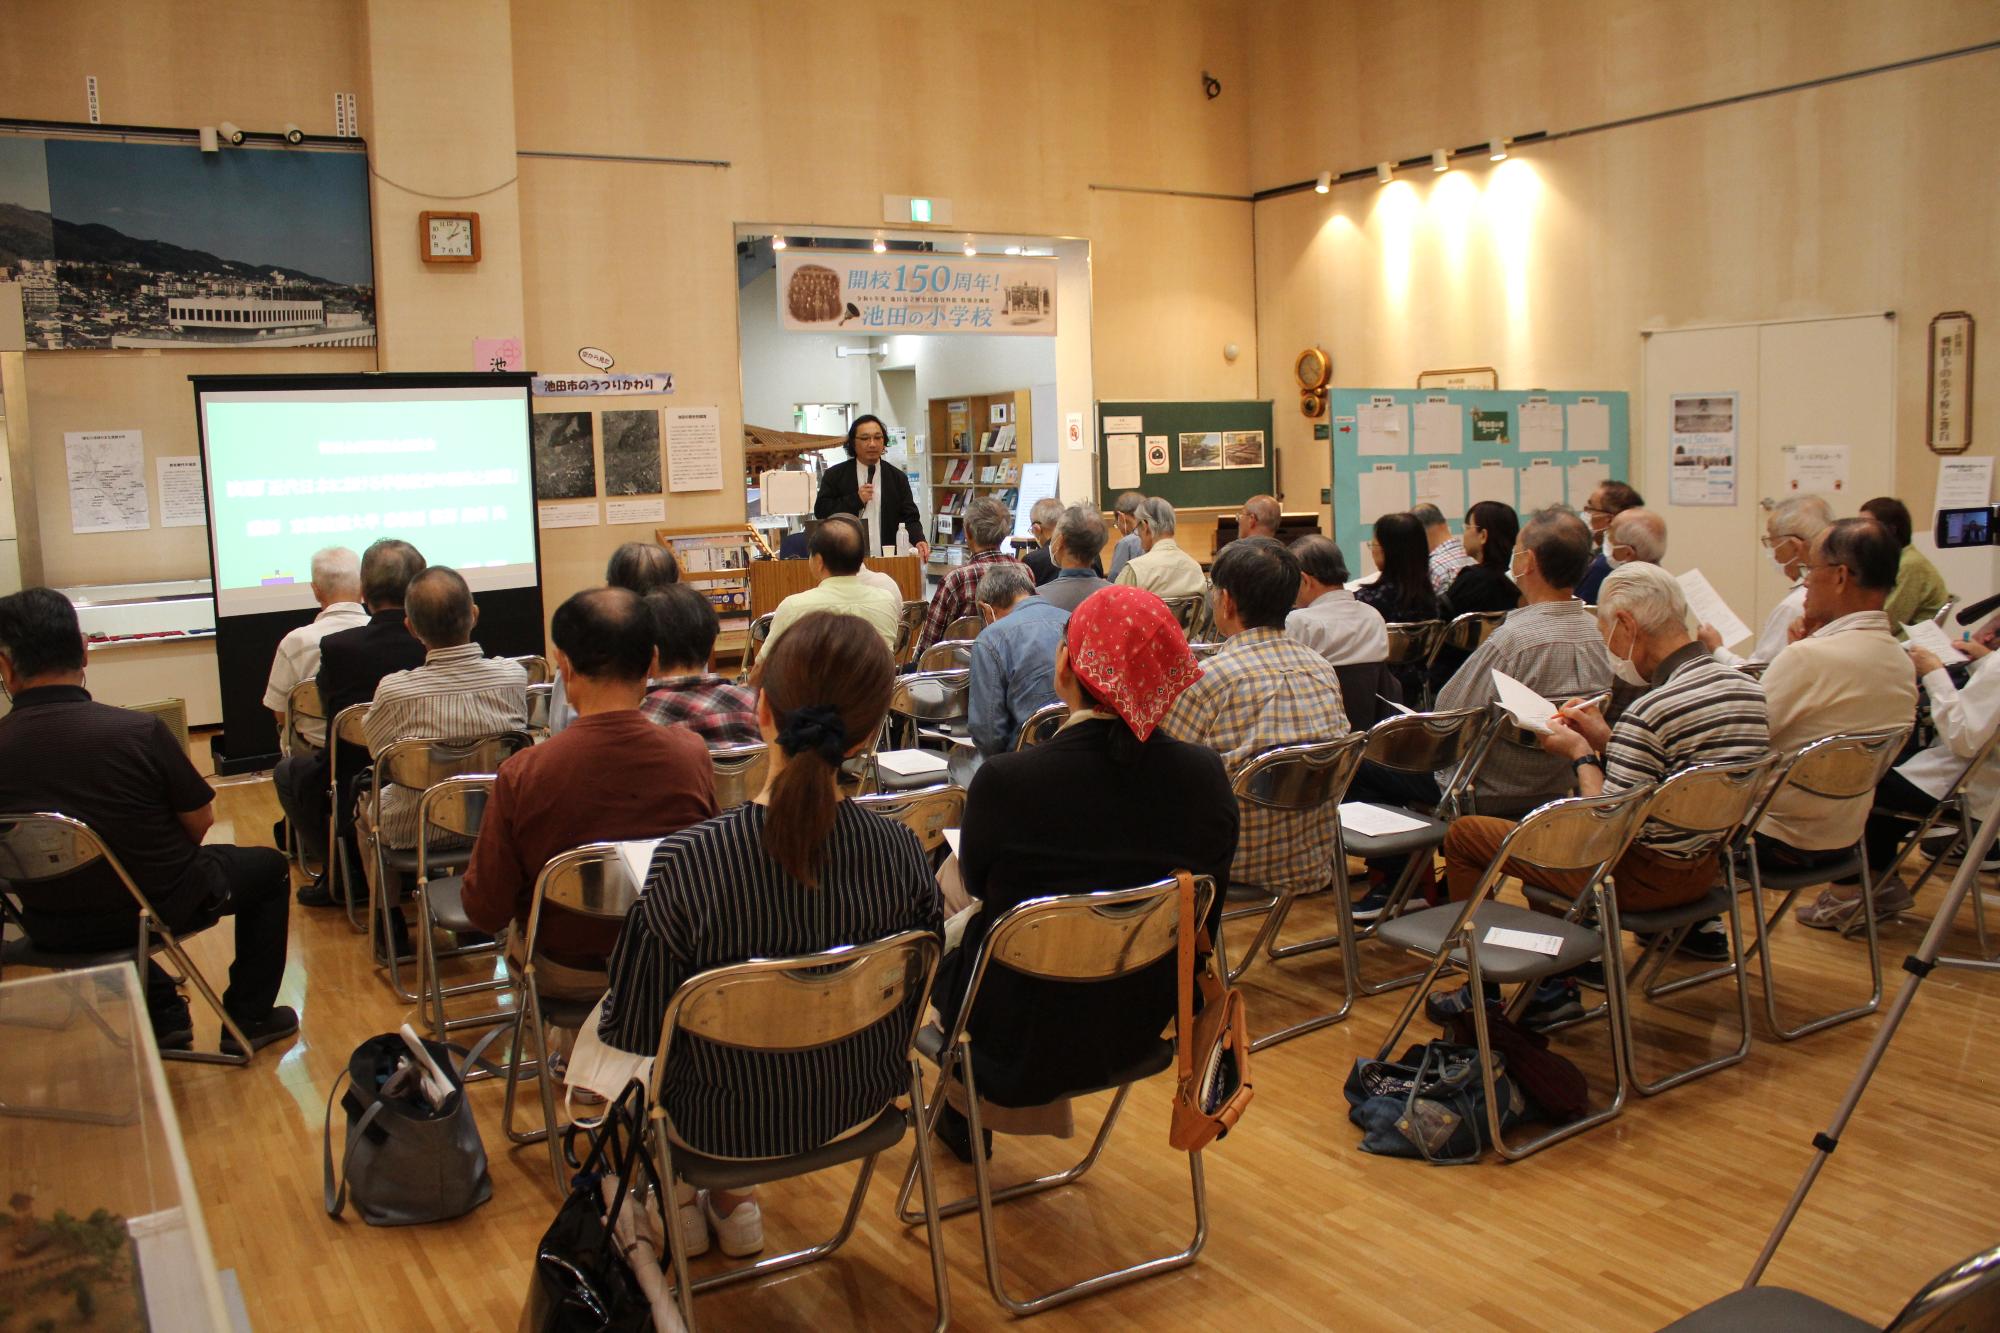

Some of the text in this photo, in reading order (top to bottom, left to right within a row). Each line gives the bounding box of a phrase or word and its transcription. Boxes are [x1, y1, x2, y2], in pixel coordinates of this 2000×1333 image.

[847, 264, 1000, 293] 開校150周年!
[863, 304, 994, 328] 池田の小学校
[490, 356, 507, 372] 池
[544, 379, 654, 392] 池田市のうつりかわり
